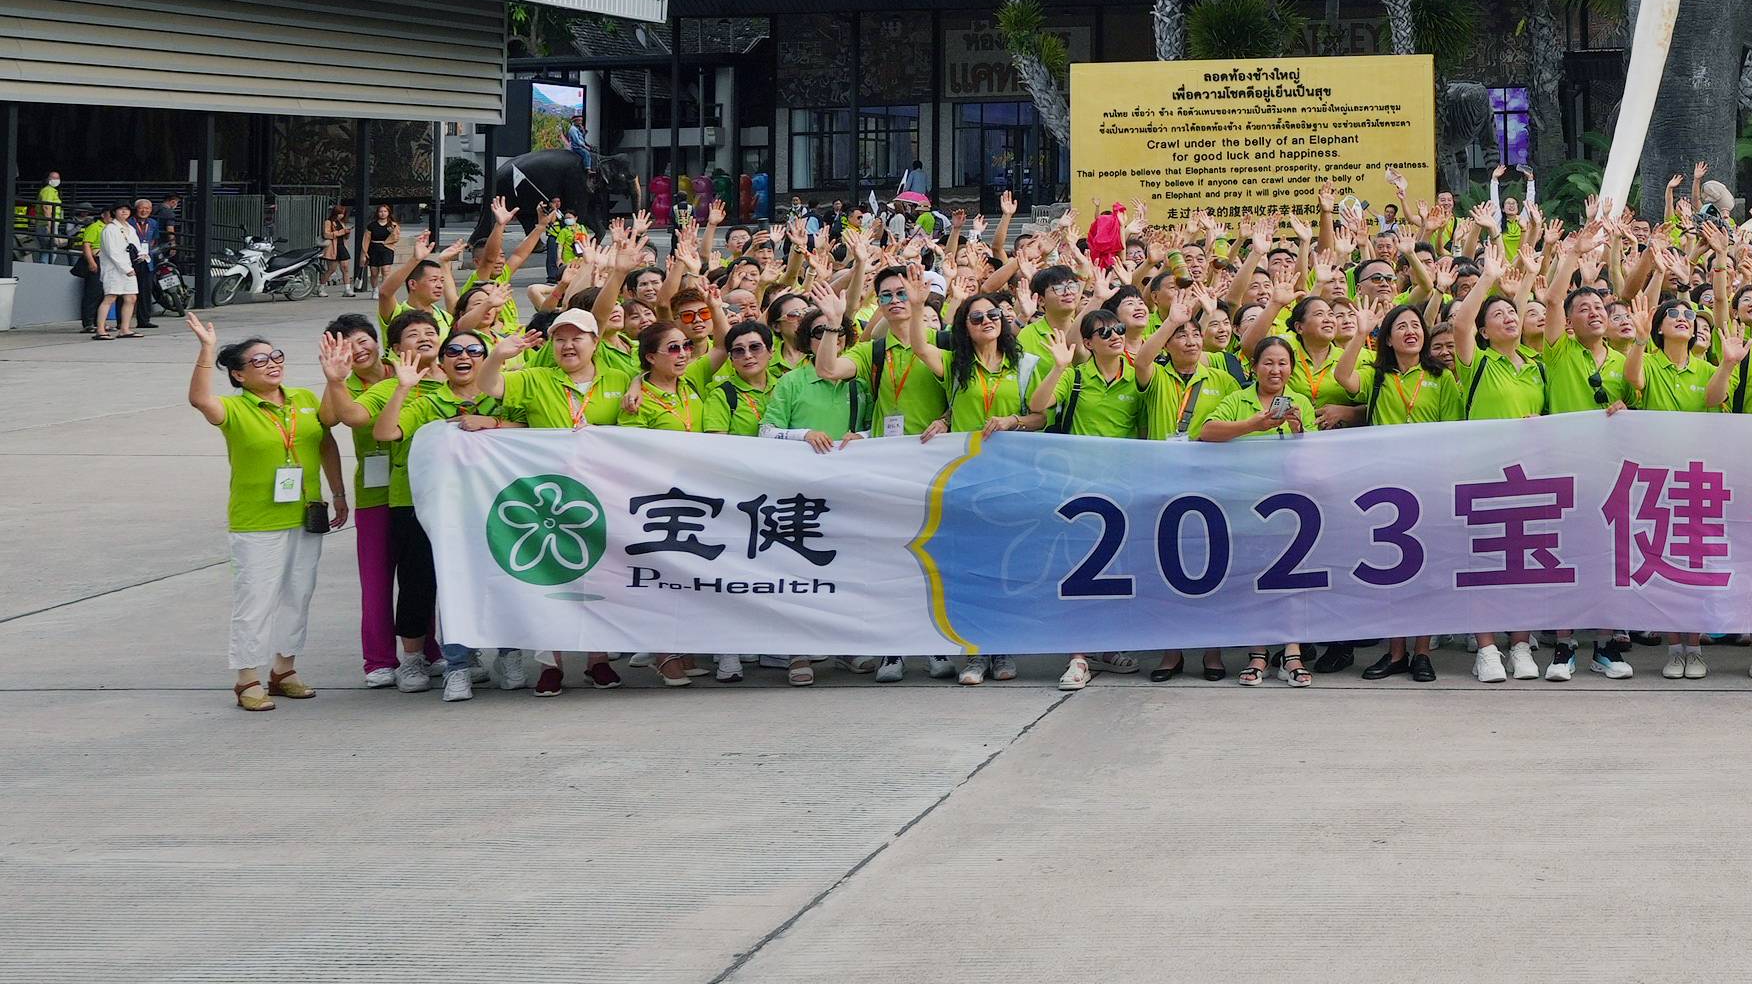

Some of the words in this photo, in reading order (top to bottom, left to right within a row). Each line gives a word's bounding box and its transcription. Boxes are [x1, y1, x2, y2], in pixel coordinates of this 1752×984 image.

[1147, 140, 1180, 150] Crawl
[1185, 139, 1217, 149] under
[1222, 138, 1240, 148] the
[1245, 137, 1272, 149] belly
[1276, 136, 1288, 146] of
[1292, 138, 1305, 146] an
[1309, 135, 1359, 148] Elephant
[1172, 153, 1189, 162] for
[1194, 152, 1223, 164] good
[1227, 151, 1250, 161] luck
[1255, 150, 1276, 160] and
[1280, 149, 1341, 161] happiness.
[1077, 169, 1095, 178] Thai
[1099, 169, 1128, 179] people
[1131, 168, 1162, 177] believe
[1165, 168, 1182, 176] that
[1186, 167, 1227, 176] Elephants
[1231, 165, 1272, 175] represent
[1275, 163, 1321, 174] prosperity,
[1325, 163, 1362, 172] grandeur
[1366, 162, 1381, 170] and
[1385, 162, 1429, 170] greatness.
[1140, 180, 1162, 189] They
[1165, 180, 1195, 188] believe
[1198, 179, 1204, 187] if
[1208, 179, 1239, 188] anyone
[1261, 176, 1284, 184] crawl
[1288, 176, 1311, 184] under
[1332, 175, 1352, 184] belly
[1356, 174, 1365, 182] of
[1166, 191, 1202, 201] Elephant
[1224, 191, 1243, 200] pray
[1247, 189, 1252, 198] it
[1256, 189, 1270, 197] will
[1273, 189, 1291, 198] give
[1294, 188, 1315, 198] good
[625, 487, 837, 566] 宝健
[626, 566, 836, 594] Pro-Health
